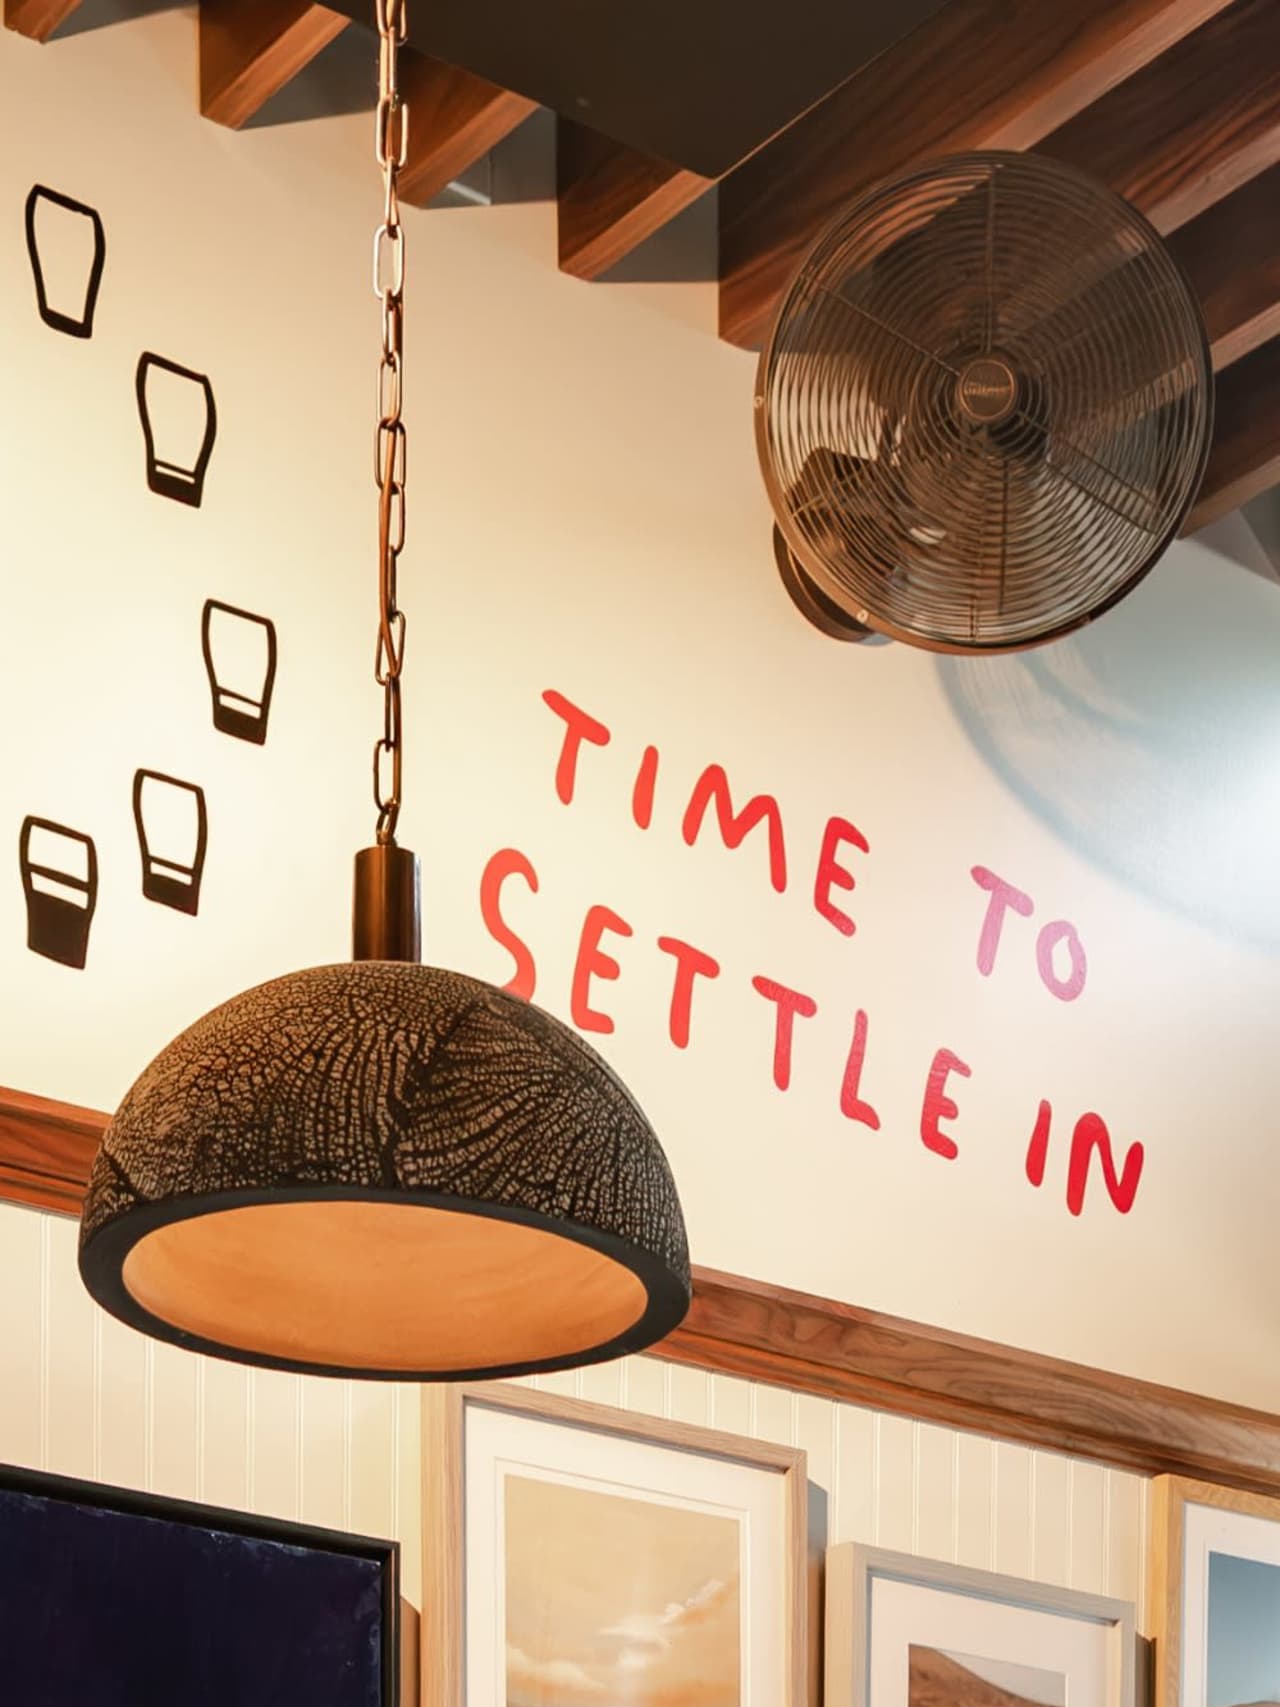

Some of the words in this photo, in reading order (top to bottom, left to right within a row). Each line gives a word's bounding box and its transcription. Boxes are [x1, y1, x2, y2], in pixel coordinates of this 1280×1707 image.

[541, 689, 870, 937] TIME
[970, 865, 1087, 1001] TO
[479, 848, 972, 1161] SETTLE
[1025, 1099, 1144, 1217] IN
